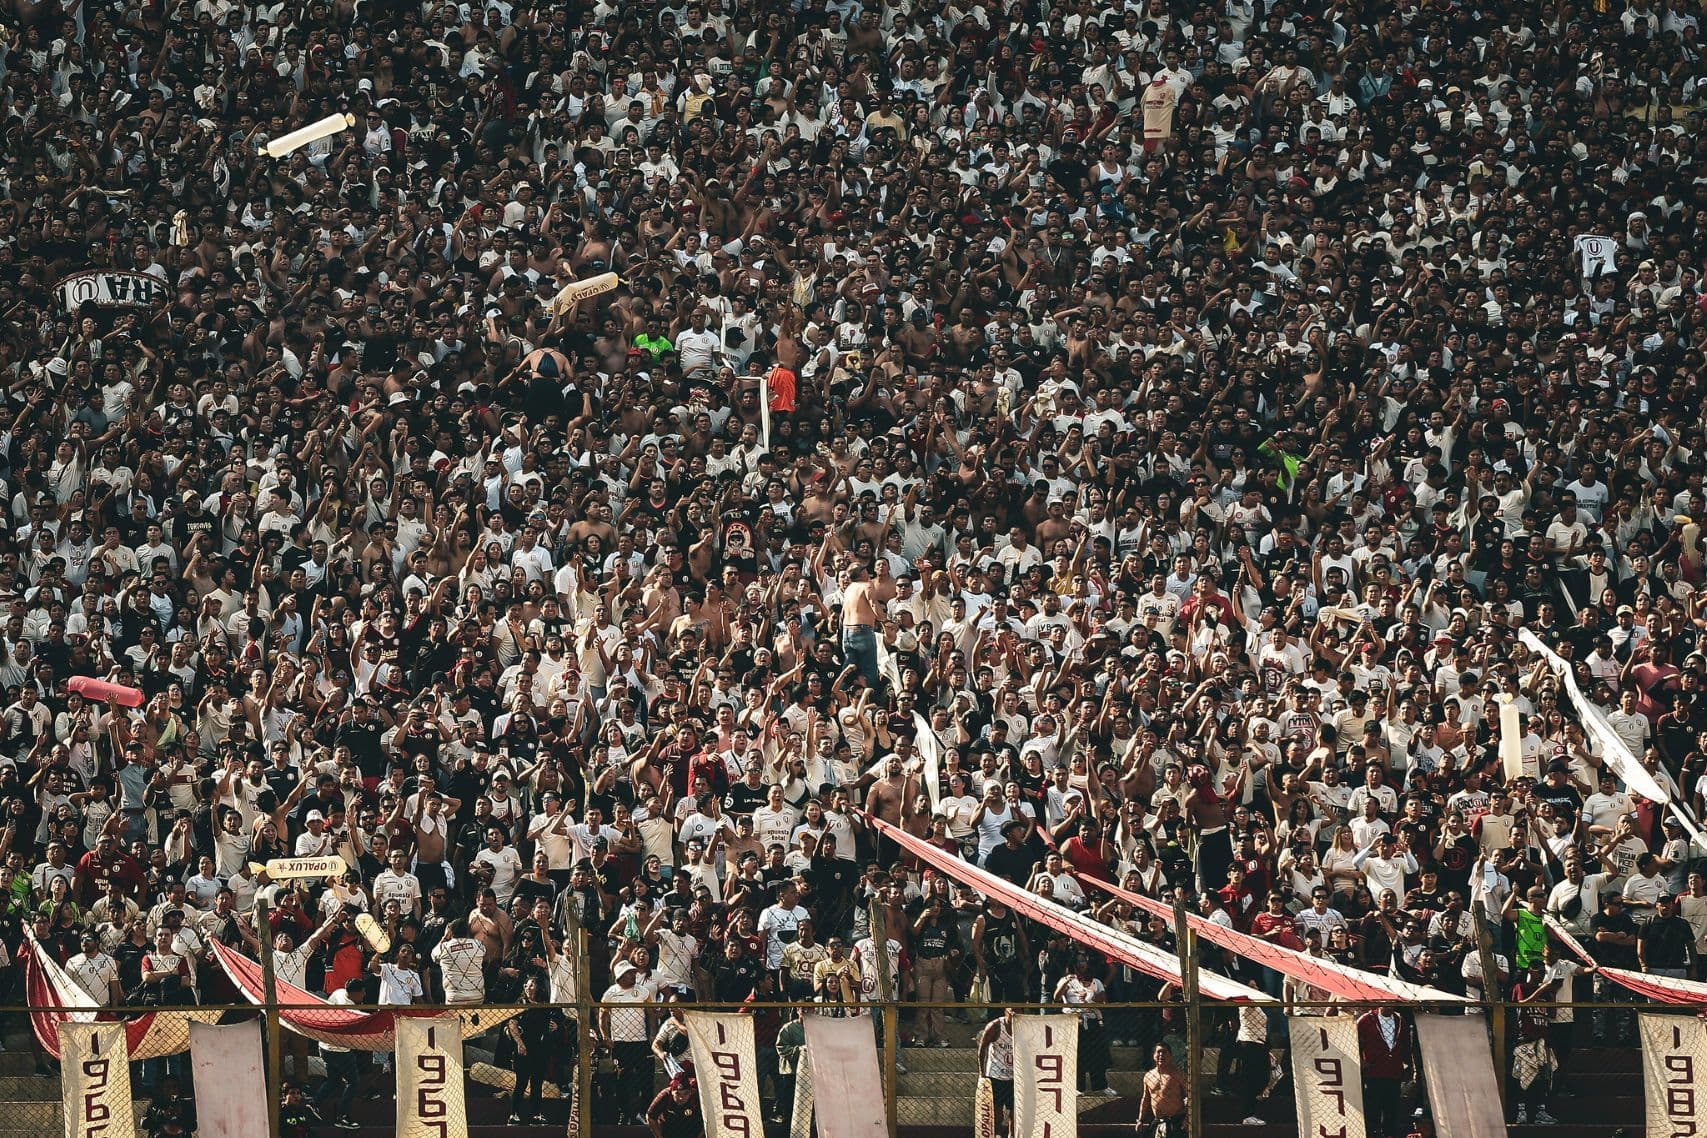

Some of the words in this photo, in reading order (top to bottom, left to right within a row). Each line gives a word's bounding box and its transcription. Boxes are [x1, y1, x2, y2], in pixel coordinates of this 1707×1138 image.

[105, 276, 157, 304] RA
[571, 288, 599, 302] OPALU
[288, 863, 327, 871] OPALUX
[711, 1021, 749, 1138] 1969
[1035, 1025, 1062, 1138] 1971
[981, 1099, 991, 1138] OPALU
